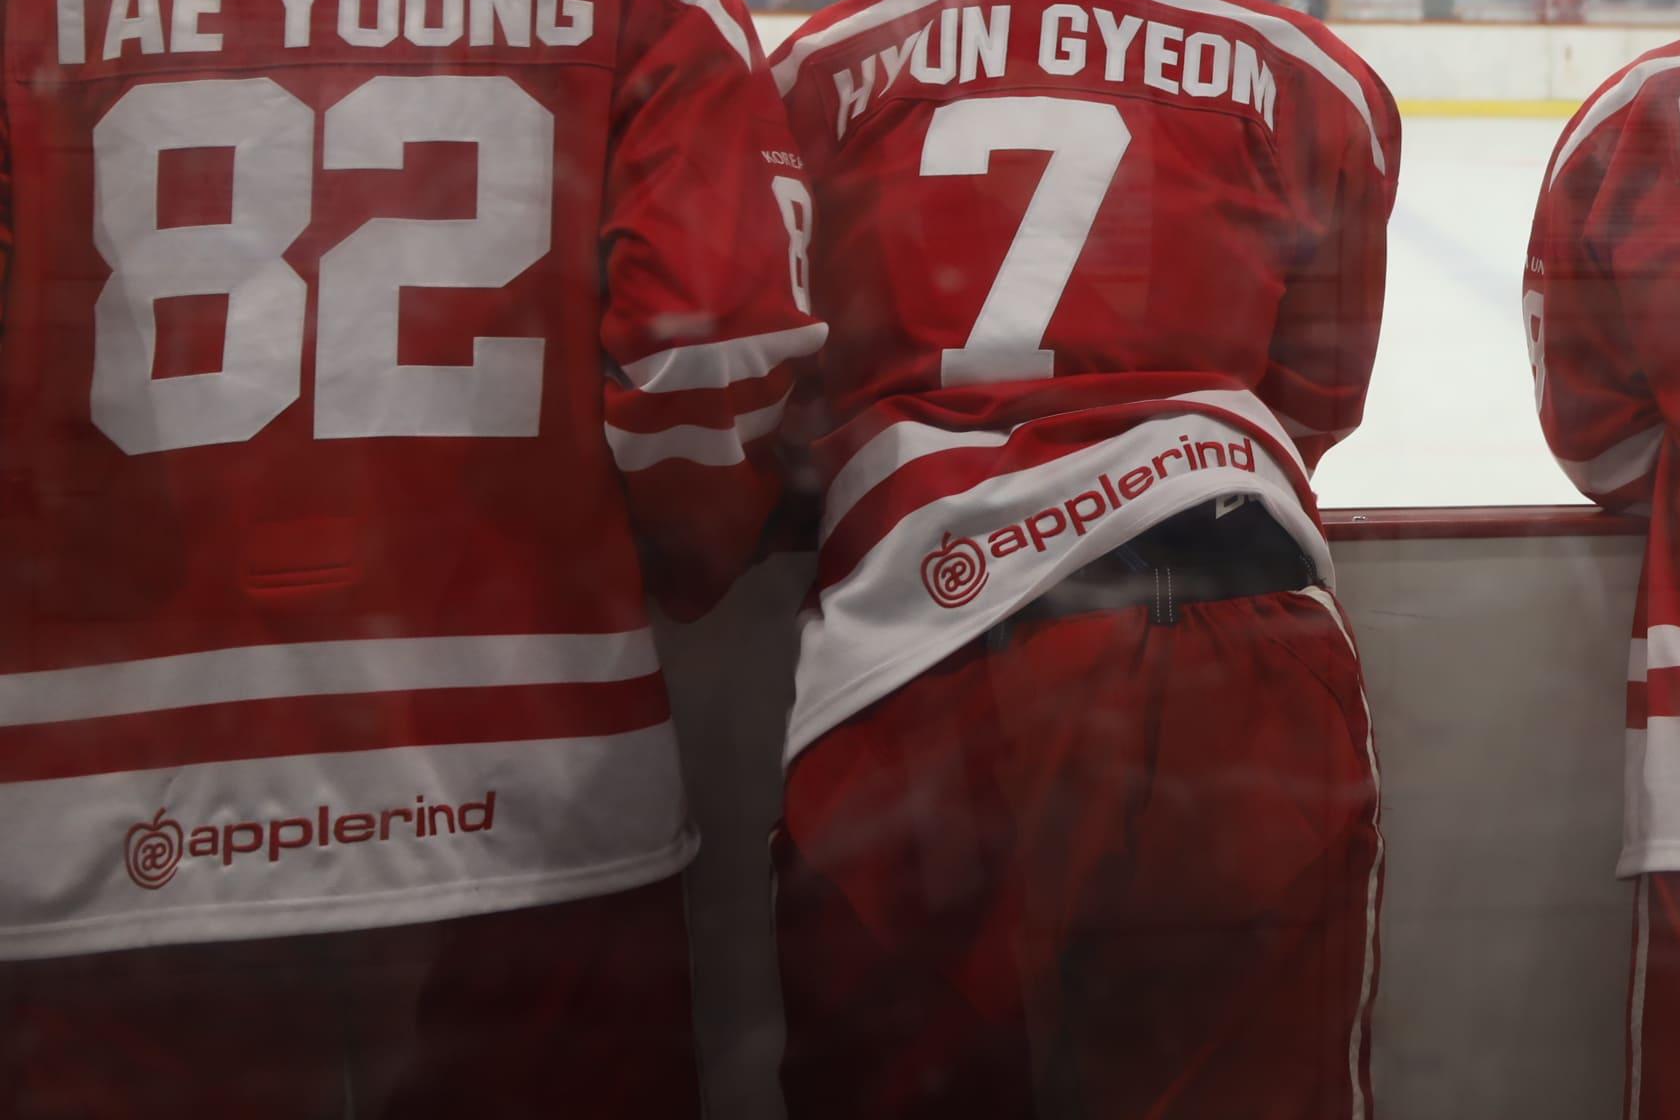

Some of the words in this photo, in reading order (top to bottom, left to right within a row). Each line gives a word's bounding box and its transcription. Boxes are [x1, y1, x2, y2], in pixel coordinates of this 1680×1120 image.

[832, 4, 1012, 142] HYUN
[1038, 3, 1278, 132] GYEOM
[89, 75, 556, 457] 82
[919, 96, 1133, 388] 7
[988, 436, 1256, 558] applerind
[189, 791, 497, 866] applerind
